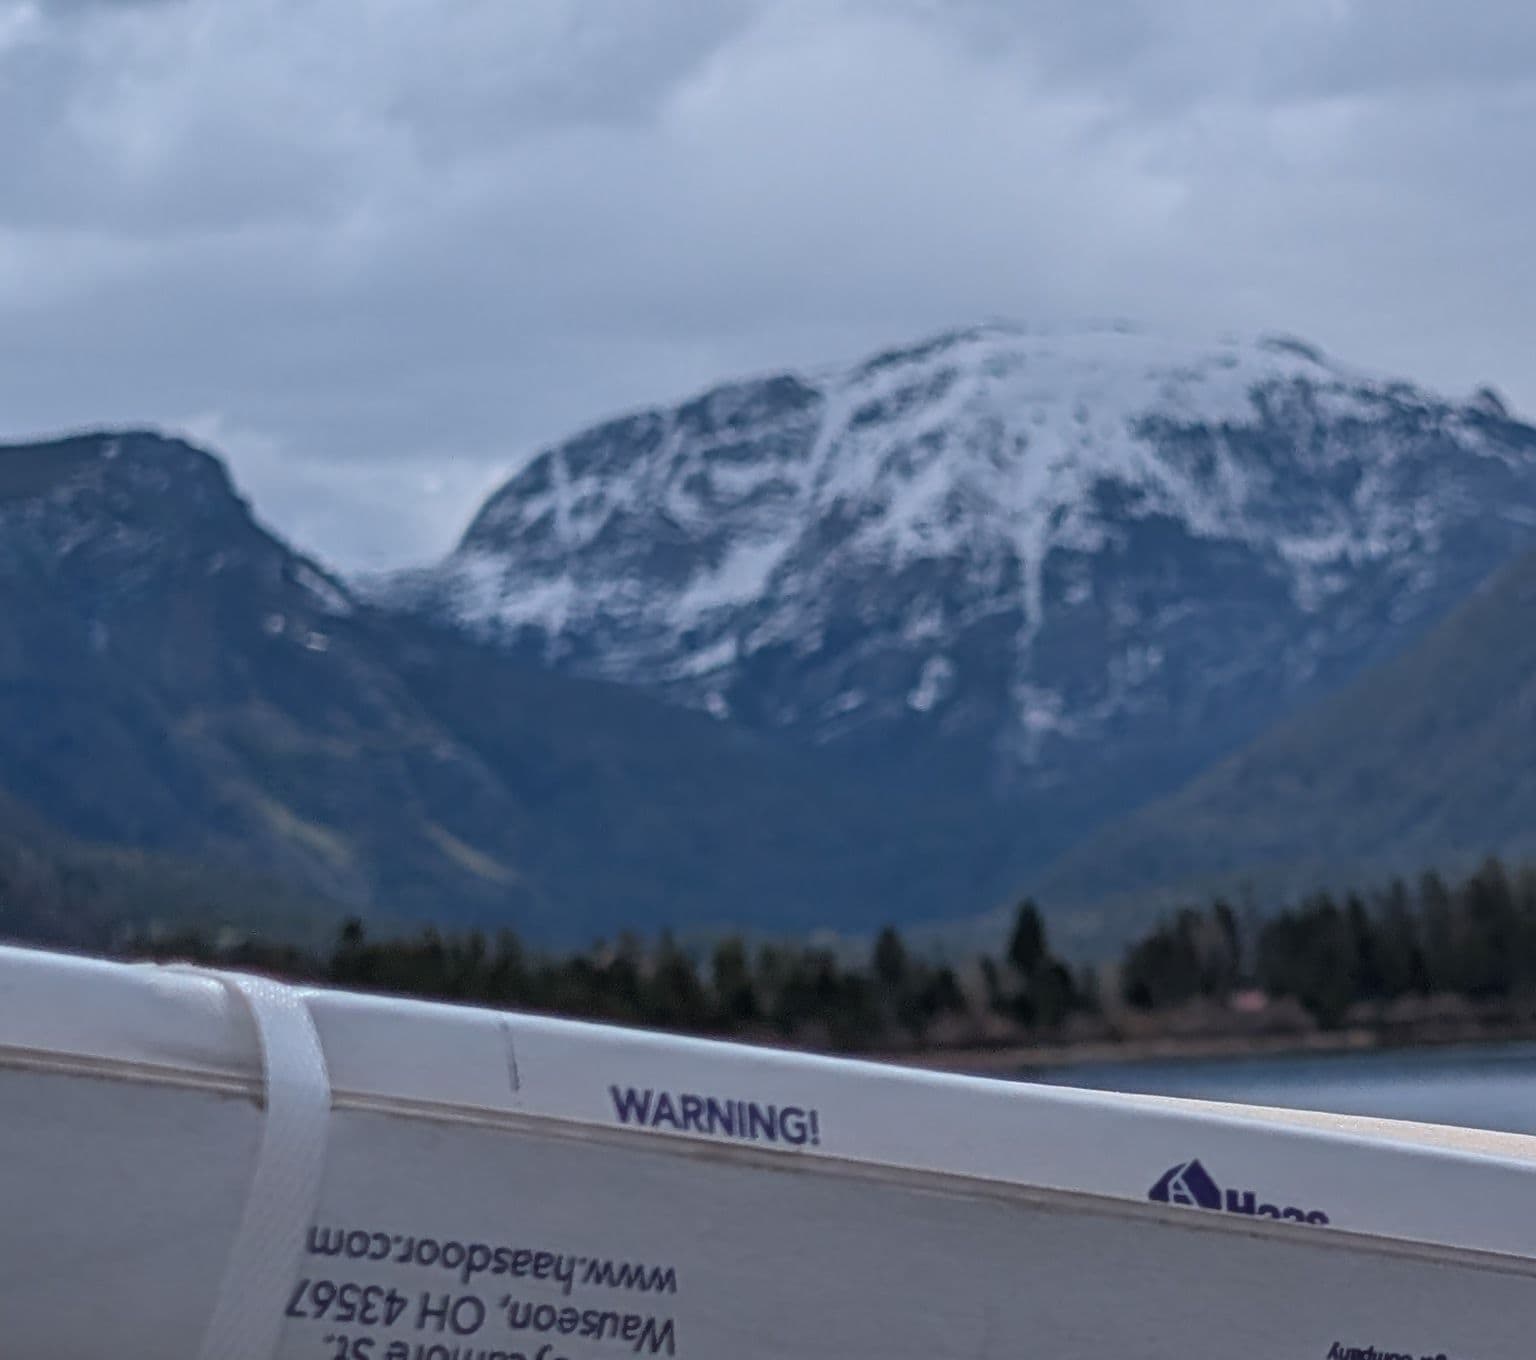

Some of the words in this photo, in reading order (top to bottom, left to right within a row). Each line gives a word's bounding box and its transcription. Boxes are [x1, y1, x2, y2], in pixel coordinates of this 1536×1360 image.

[610, 1085, 820, 1145] WARNING!
[305, 1224, 677, 1295] www.haasdoor.com
[284, 1278, 408, 1327] 43567
[416, 1292, 485, 1335] OH
[502, 1294, 676, 1356] Wauseon,
